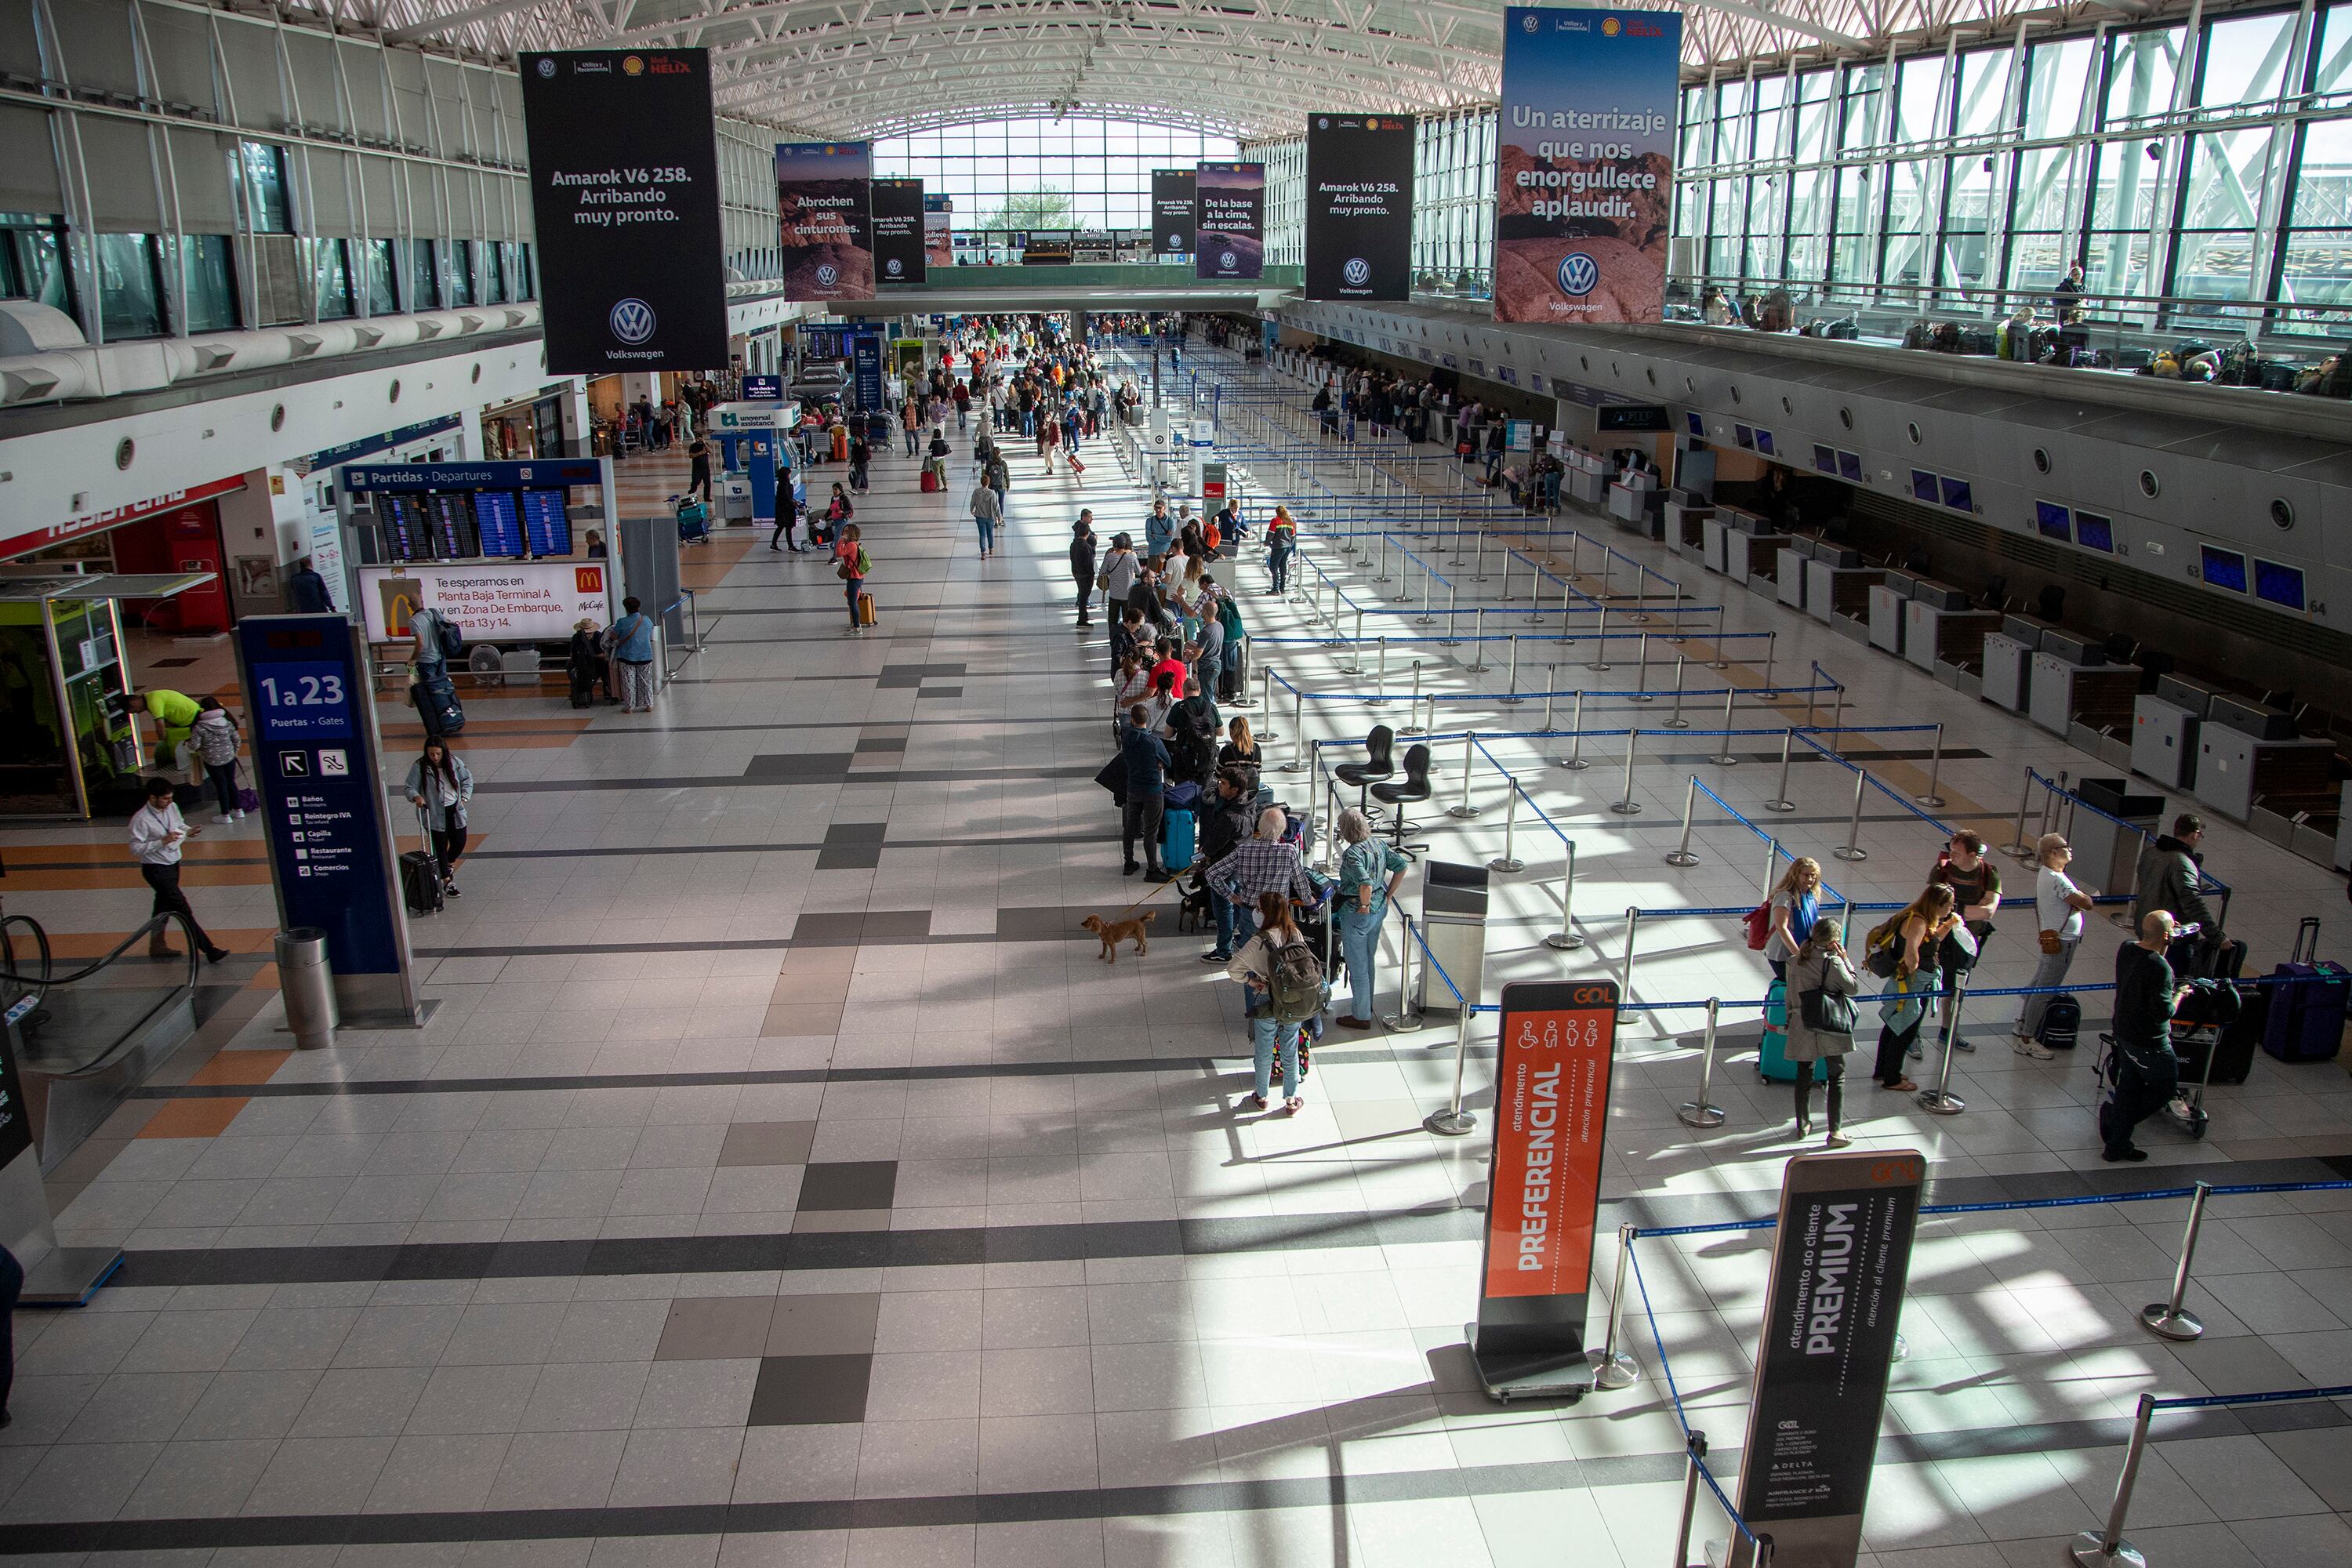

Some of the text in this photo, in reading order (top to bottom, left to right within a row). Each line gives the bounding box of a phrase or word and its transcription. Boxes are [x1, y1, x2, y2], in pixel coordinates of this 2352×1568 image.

[1627, 26, 1664, 37] HELIX
[650, 61, 691, 74] HELIX
[1512, 105, 1666, 136] Un aterrizaje
[1538, 140, 1632, 163] que nos
[551, 167, 692, 187] Amarok V6 258.
[1515, 166, 1656, 194] enorgullece
[1319, 183, 1399, 192] Amarok V6 258.
[580, 187, 666, 205] Arribando
[797, 196, 854, 208] Abrochen
[1334, 194, 1383, 203] Arribando
[1205, 198, 1253, 208] De la base
[1532, 195, 1636, 222] aplaudir.
[816, 212, 837, 220] sus
[1214, 209, 1224, 219] la
[1225, 209, 1250, 220] cima,
[1330, 206, 1389, 216] muy pronto.
[574, 209, 680, 227] muy pronto.
[794, 223, 860, 235] cinturones.
[1202, 220, 1254, 230] sin escalas.
[1549, 301, 1602, 313] Volkswagen
[606, 350, 665, 360] Volkswagen
[371, 470, 492, 484] Partidas Departures
[2027, 518, 2035, 531] 61
[2118, 543, 2129, 557] 62
[435, 578, 449, 588] Te
[450, 579, 509, 589] esperamos
[437, 589, 551, 603] Planta Baja Terminal A
[463, 604, 488, 615] Zona
[491, 604, 505, 614] De
[507, 602, 563, 615] Embarque,
[2310, 600, 2326, 615] 64
[477, 618, 488, 627] 13
[489, 619, 495, 629] y
[497, 617, 511, 627] 14.
[261, 675, 344, 706] 1 a 23
[271, 717, 344, 727] Puertas Gates
[304, 812, 339, 821] Reintegro
[310, 846, 352, 855] Restaurante
[1573, 986, 1613, 1004] GOL
[1512, 1062, 1527, 1132] atendimento
[1581, 1059, 1596, 1143] atención preferencial
[1518, 1062, 1561, 1272] PREFERENCIAL
[1871, 1160, 1918, 1183] GOL
[1868, 1196, 1896, 1327] atención al cliente premium
[1791, 1204, 1821, 1349] atendimento ao cliente
[1806, 1203, 1858, 1355] PREMIUM
